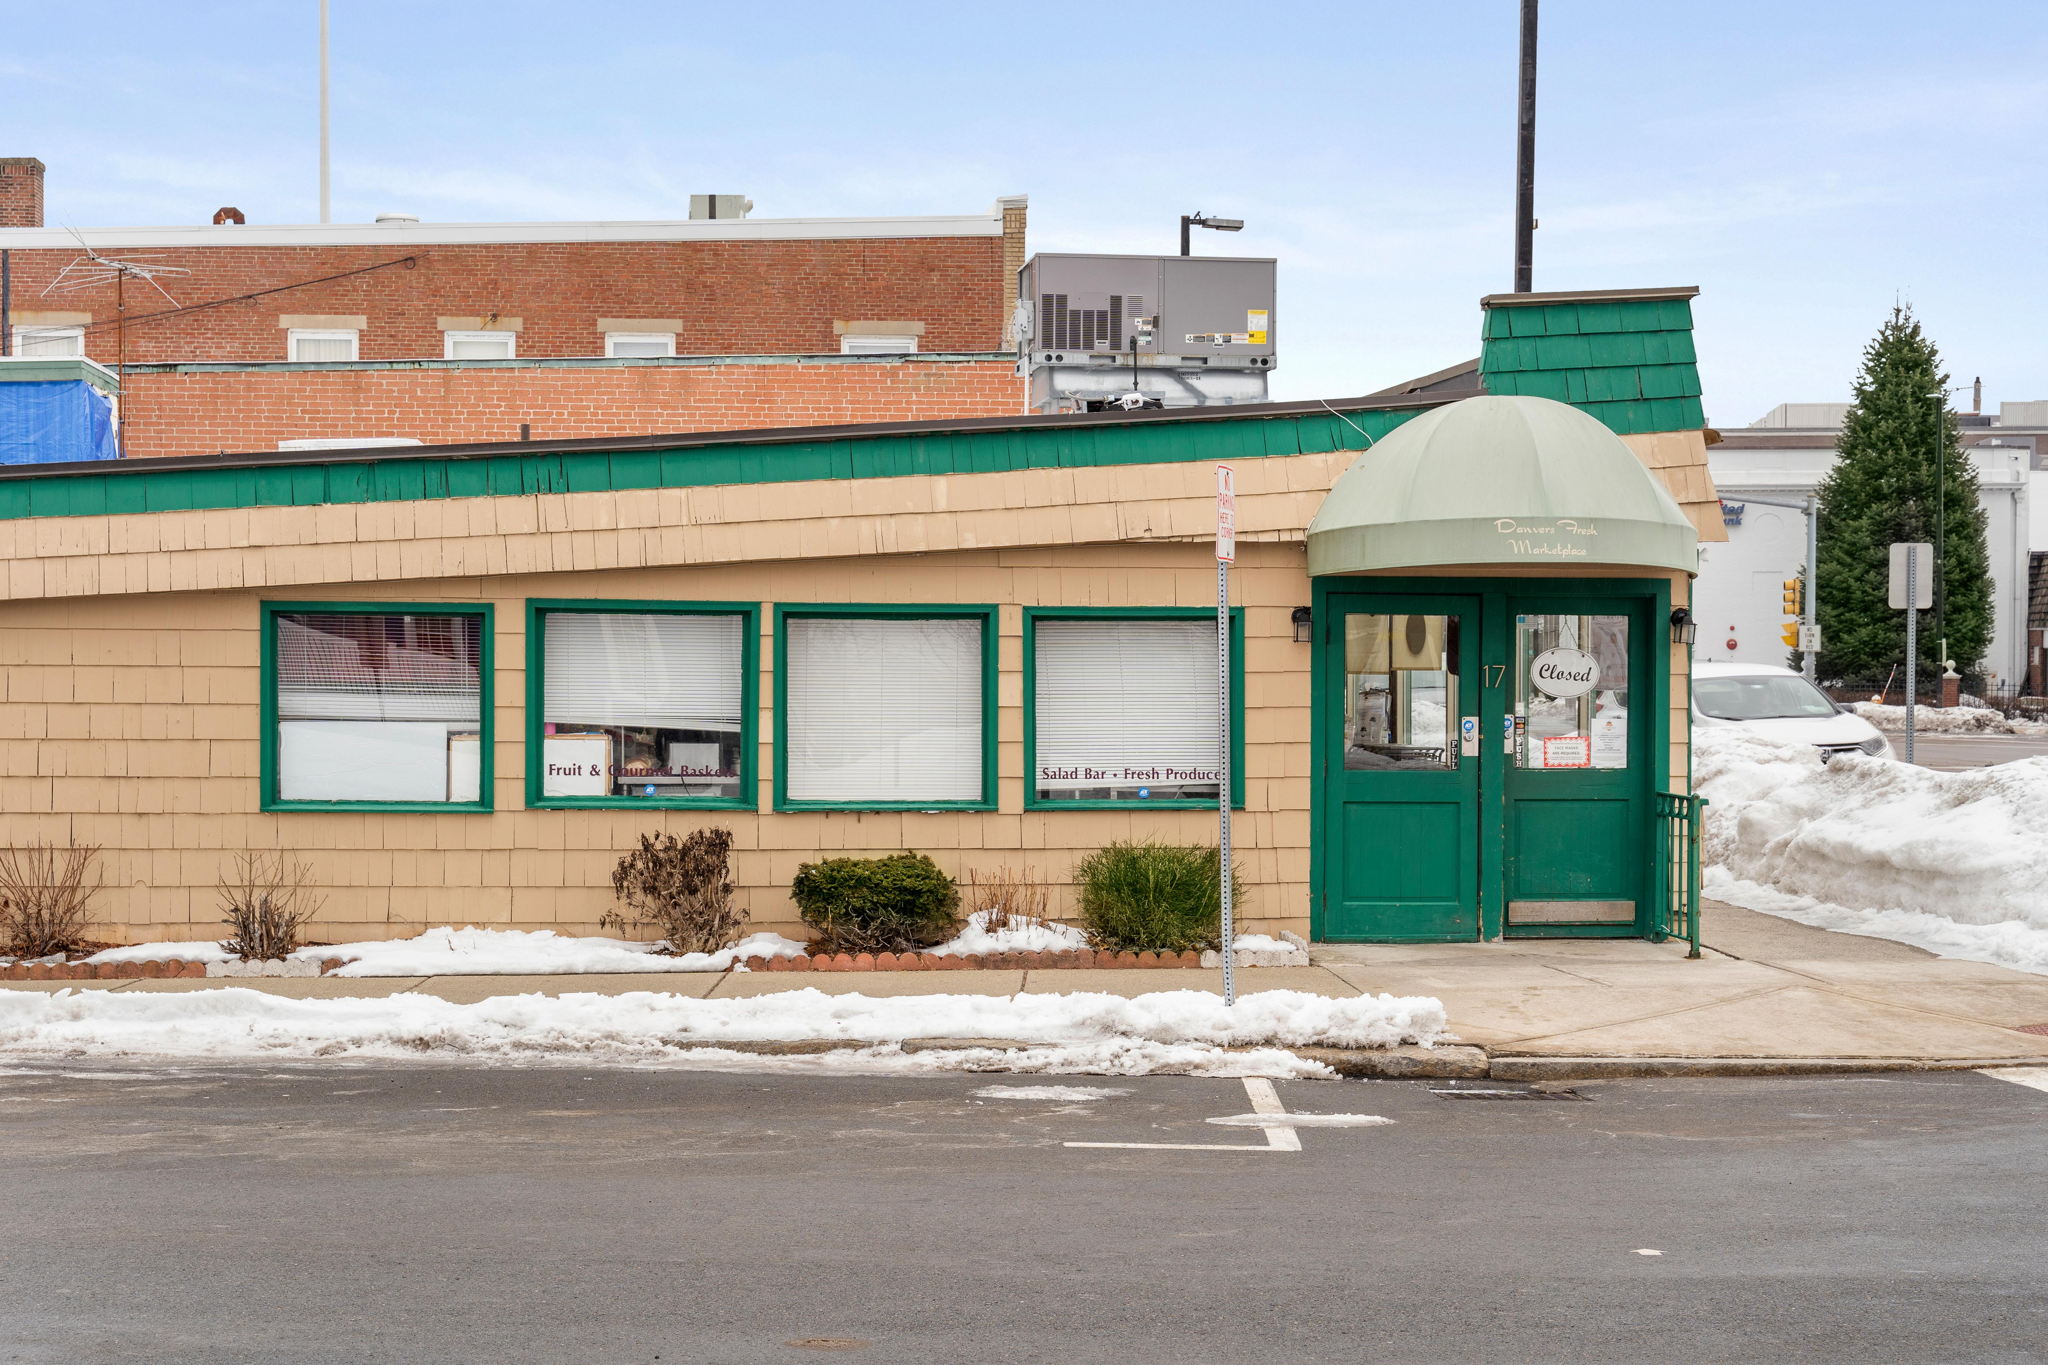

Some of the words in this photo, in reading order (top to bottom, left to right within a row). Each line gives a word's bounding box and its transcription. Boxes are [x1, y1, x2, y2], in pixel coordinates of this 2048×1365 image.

[1494, 518, 1555, 534] Danvers
[1556, 519, 1598, 535] Fresh
[1505, 540, 1587, 558] Marketplace
[1483, 665, 1506, 688] 17
[1539, 663, 1592, 682] Closed
[1515, 737, 1523, 768] PUSH
[549, 763, 582, 776] Fruit
[589, 764, 601, 776] &
[608, 765, 673, 778] Gourmet
[681, 766, 737, 778] Baskets
[1042, 768, 1078, 780] Salad
[1084, 769, 1106, 780] Bar
[1124, 768, 1160, 780] Fresh
[1166, 768, 1220, 780] Produce
